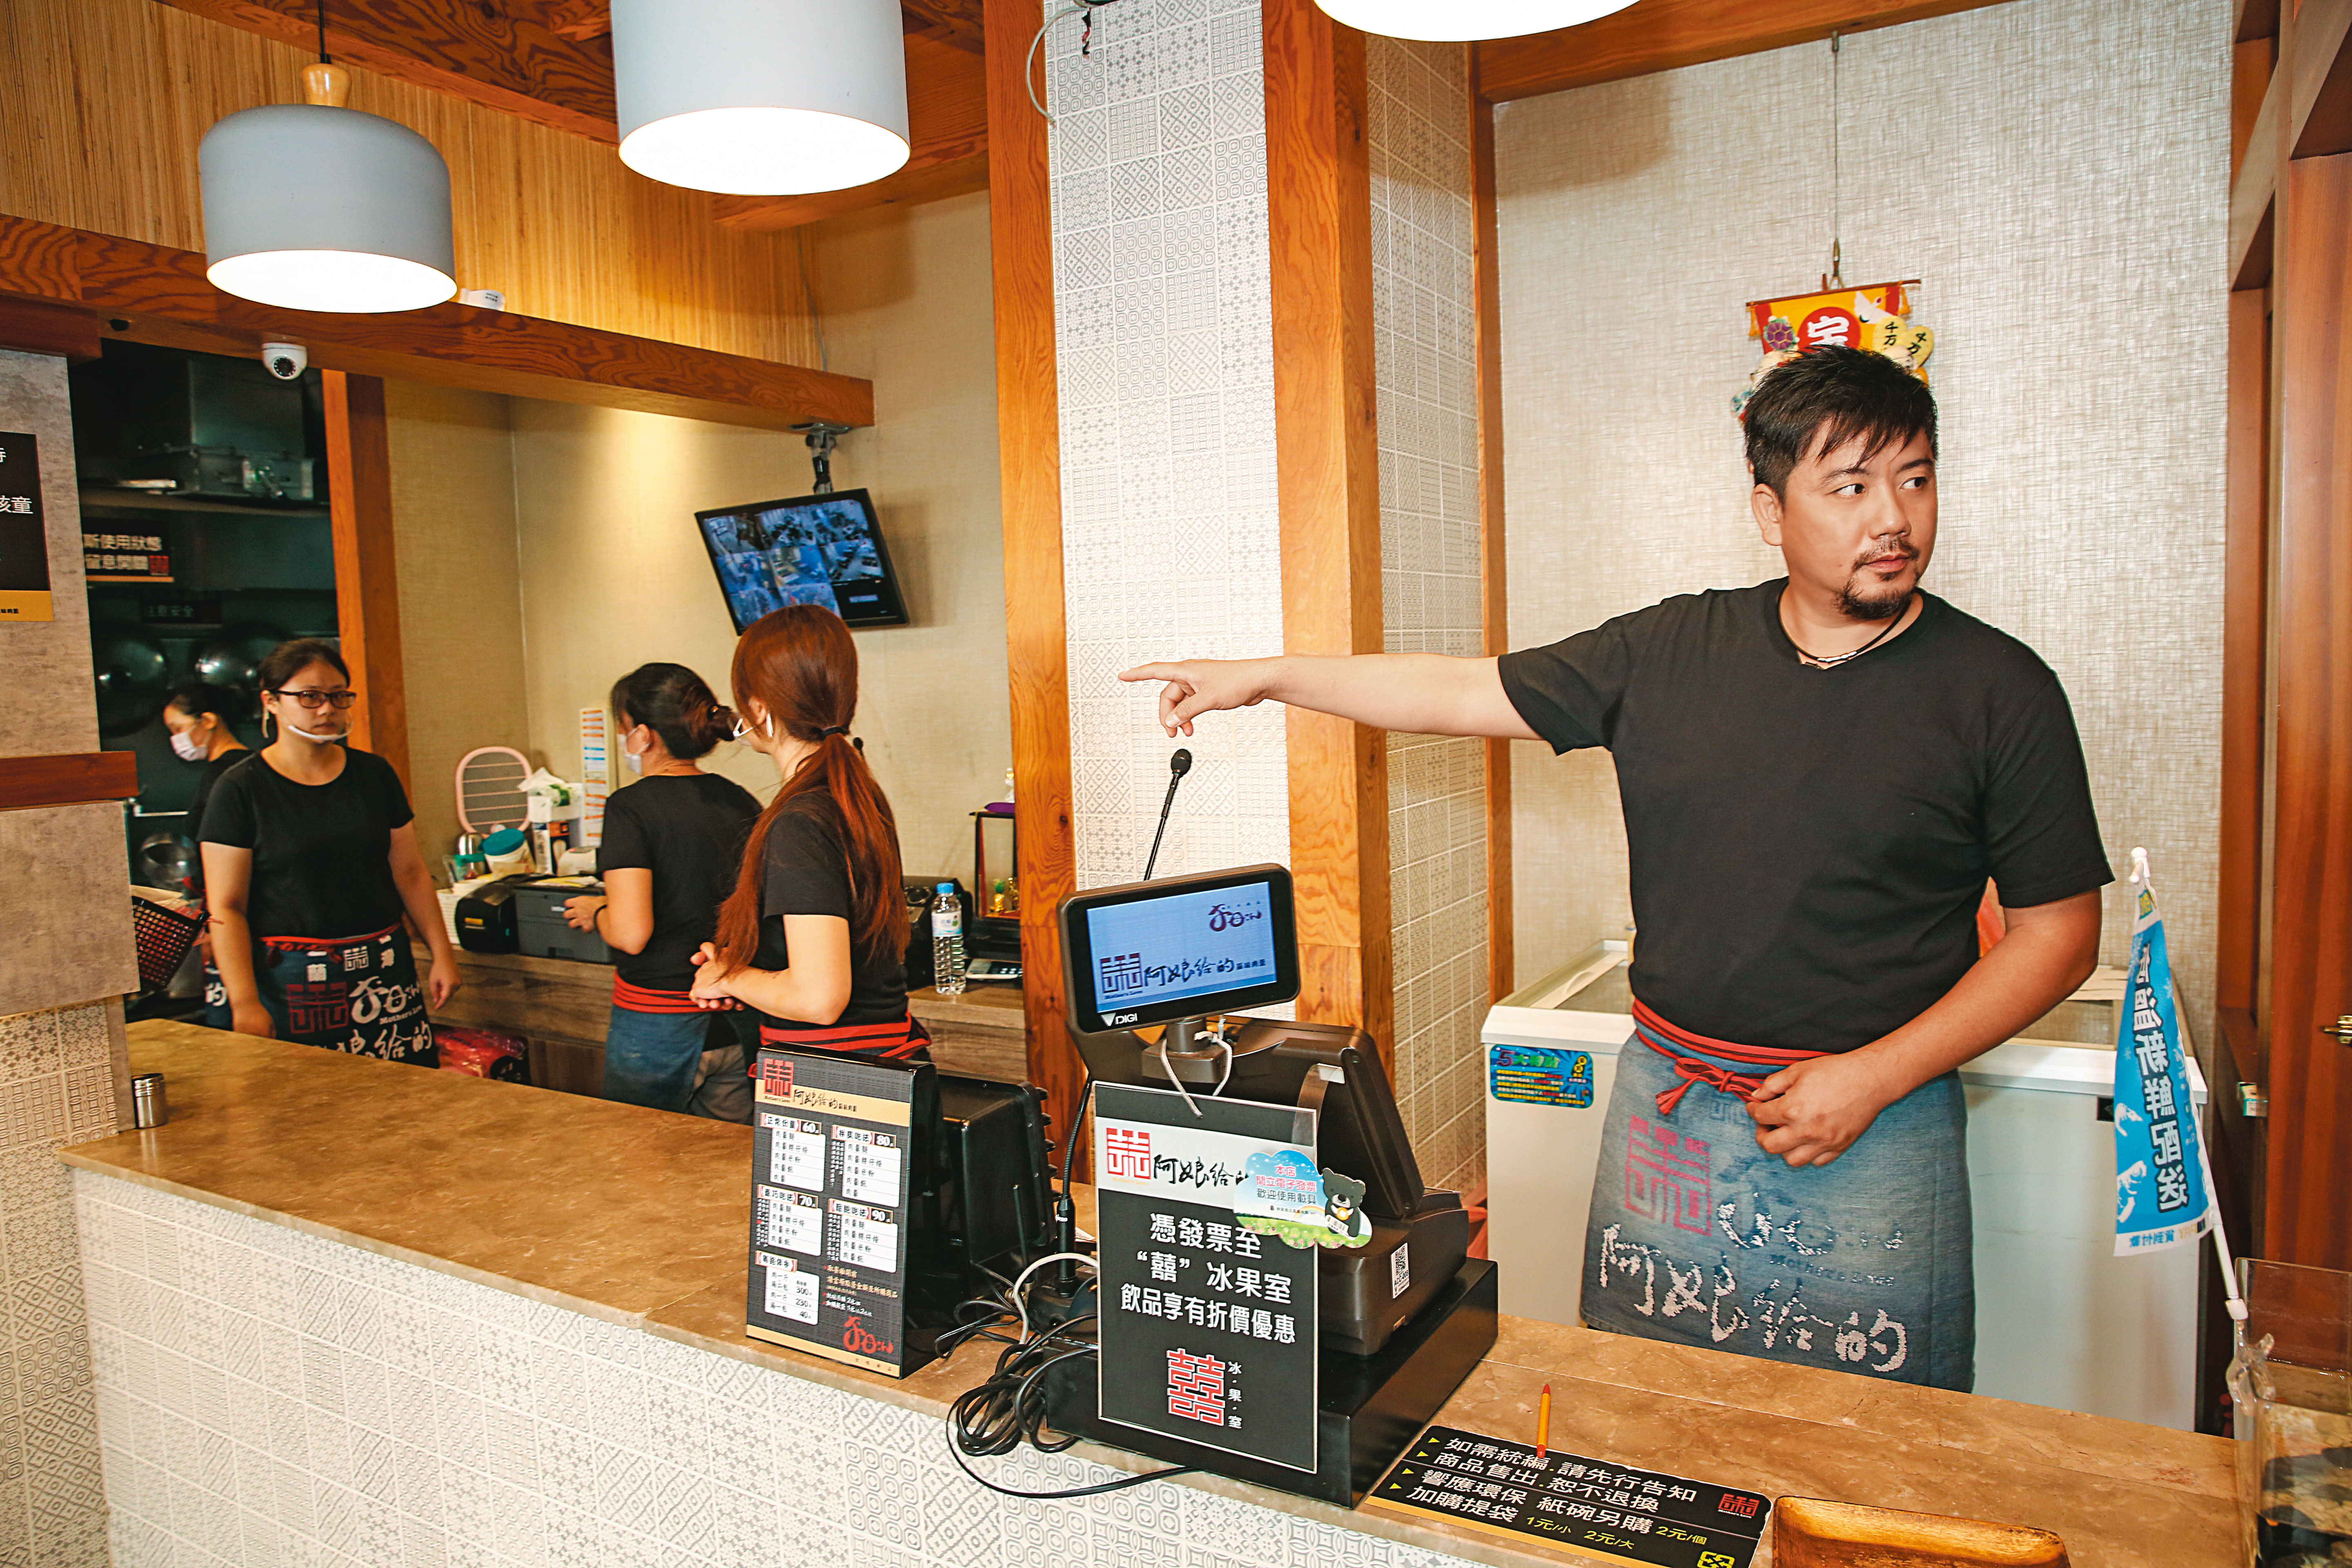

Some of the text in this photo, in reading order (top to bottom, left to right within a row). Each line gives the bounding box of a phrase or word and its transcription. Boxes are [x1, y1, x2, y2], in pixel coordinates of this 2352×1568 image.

[1115, 1013, 1138, 1025] DIGI
[1256, 1175, 1317, 1192] 開立電子發票
[1275, 1165, 1296, 1177] 本店
[1256, 1188, 1317, 1205] 歡迎使用載具
[1150, 1213, 1262, 1259] 憑發票至
[1206, 1261, 1292, 1304] 冰果室
[1120, 1283, 1296, 1344] 飲品享有折價優惠
[1406, 1485, 1635, 1550] 加購提袋 1元/小 2元/大
[1421, 1469, 1707, 1545] 響應環保 紙碗另購 2元/個
